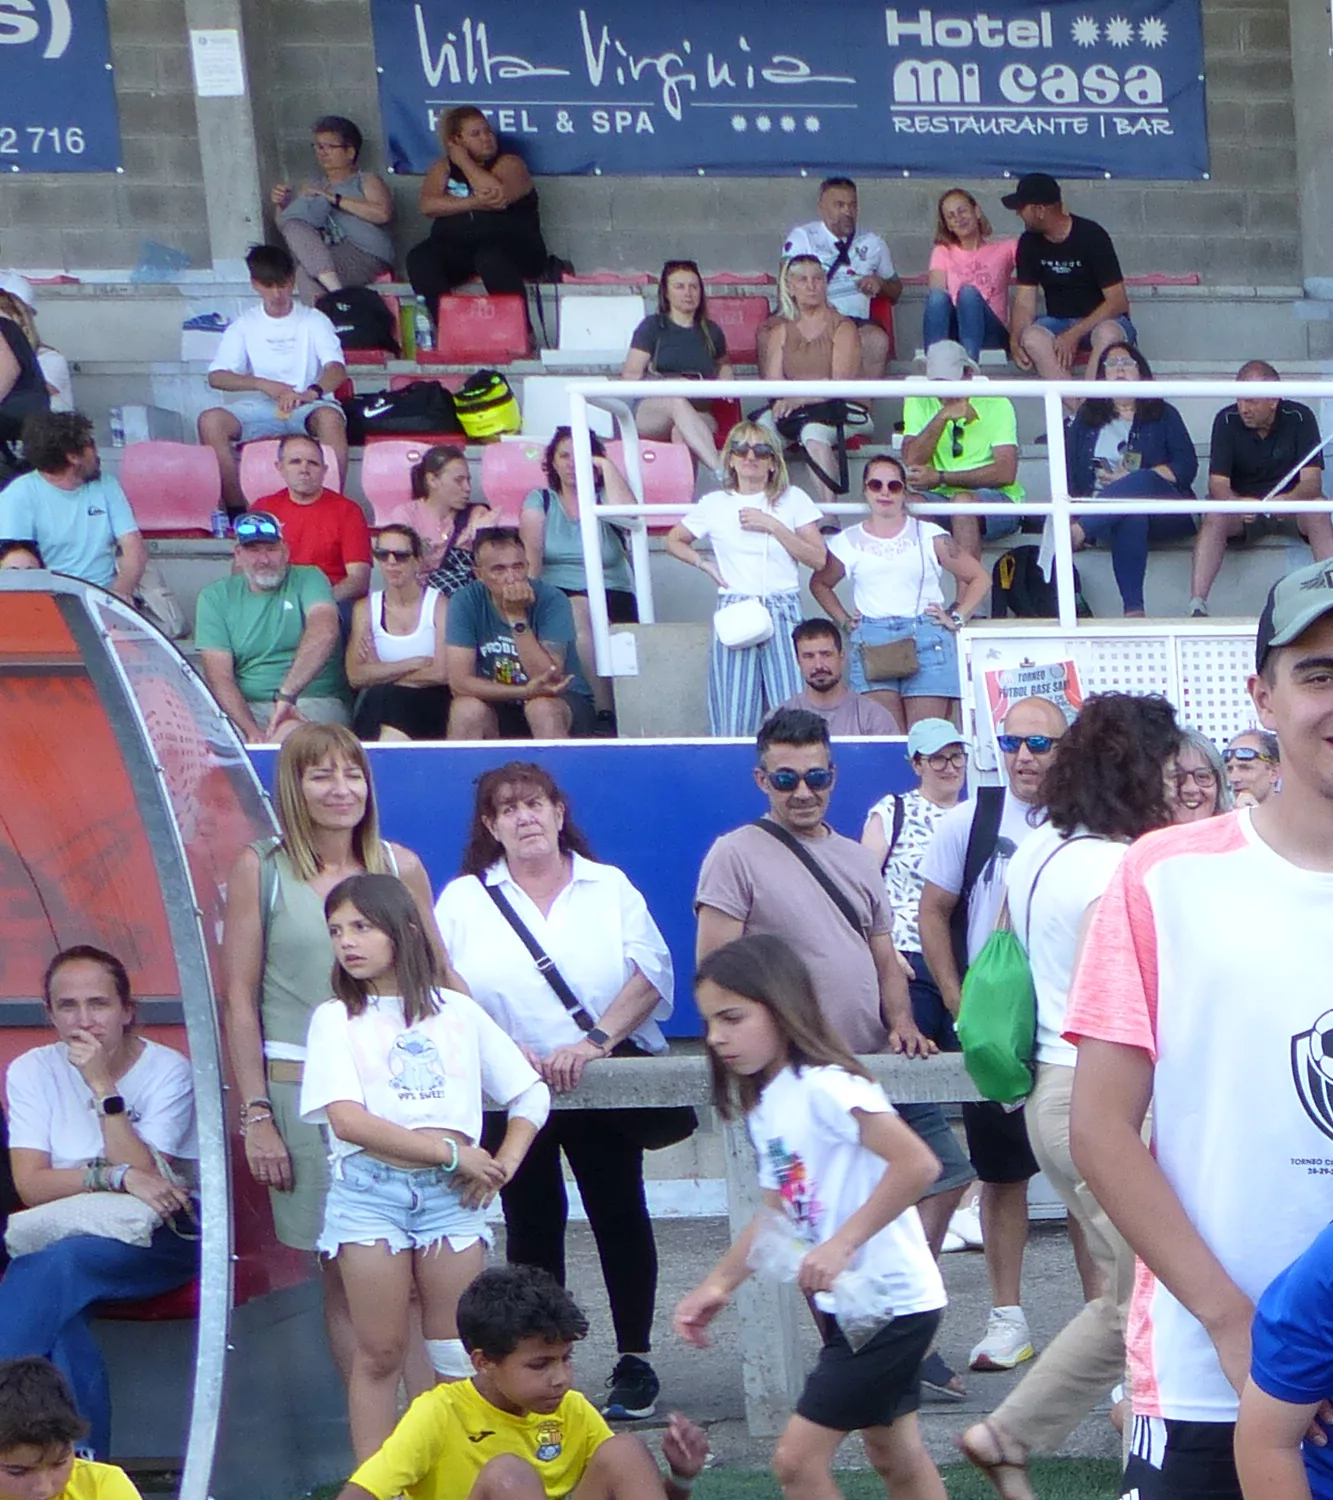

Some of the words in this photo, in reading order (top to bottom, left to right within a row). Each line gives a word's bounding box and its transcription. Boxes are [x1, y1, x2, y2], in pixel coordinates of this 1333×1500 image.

[885, 9, 1053, 48] Hotel
[414, 3, 570, 88] Villa
[579, 9, 857, 121] Virginia
[999, 63, 1163, 105] casa
[555, 111, 575, 133] &
[592, 110, 655, 134] SPA
[892, 115, 1088, 134] RESTAURANTE
[1116, 117, 1174, 136] BAR
[26, 126, 86, 154] 716
[1017, 669, 1046, 684] TORNEO
[1030, 683, 1051, 696] BASE
[1290, 1157, 1322, 1167] TORNEO
